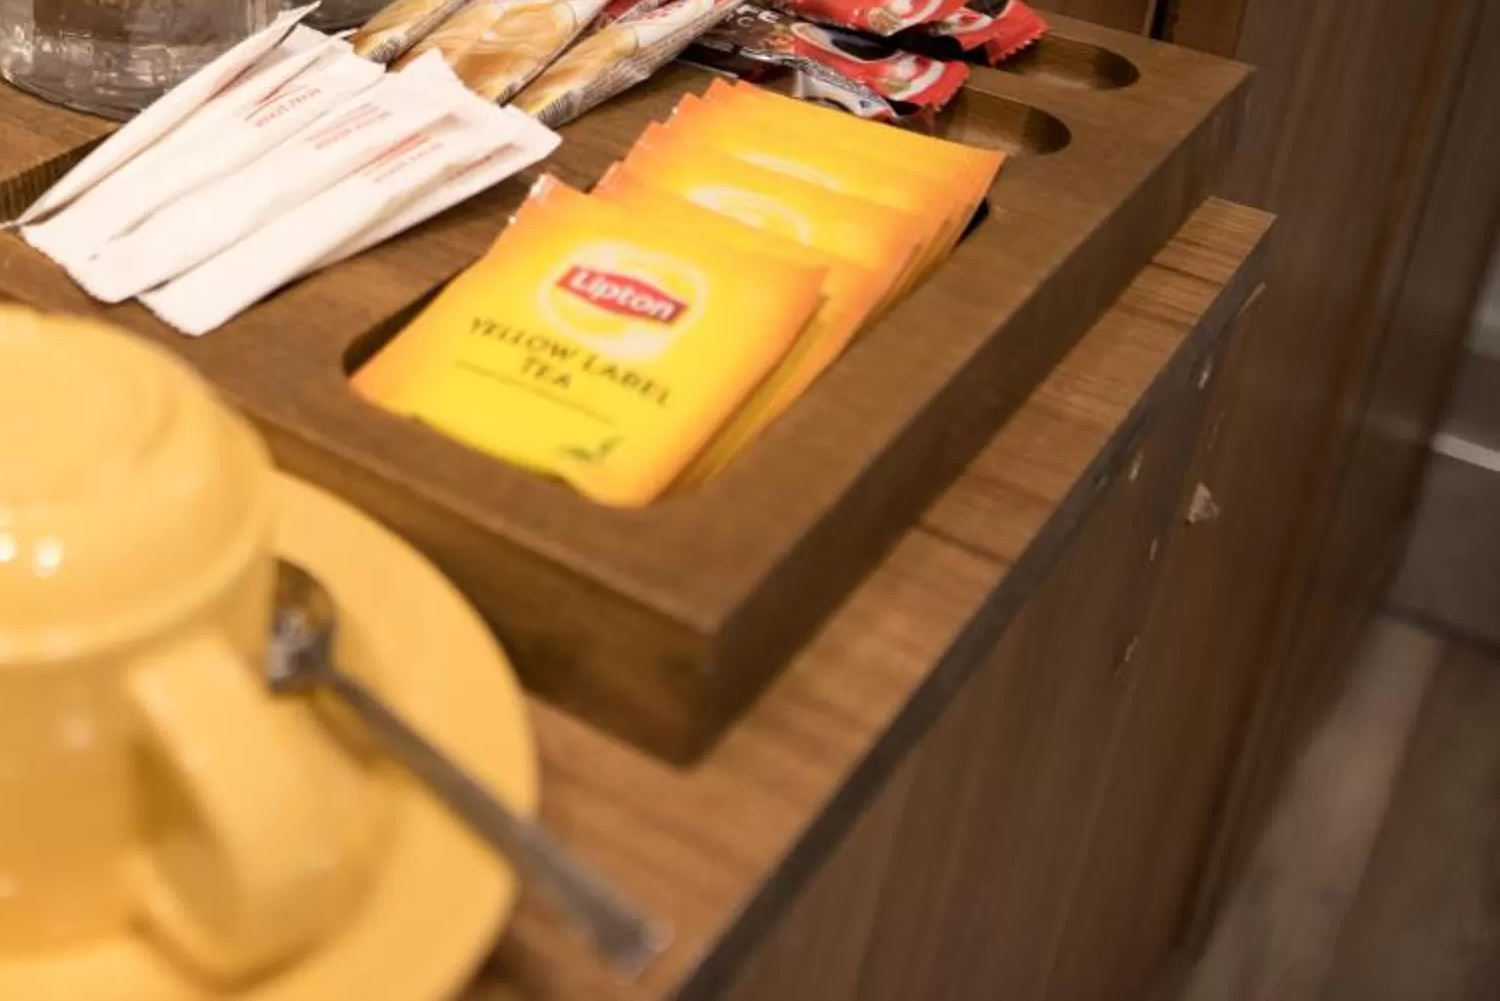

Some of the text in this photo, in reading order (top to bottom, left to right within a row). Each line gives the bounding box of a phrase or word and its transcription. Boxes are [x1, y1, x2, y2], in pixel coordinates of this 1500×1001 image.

[567, 269, 678, 321] Lipton
[468, 316, 672, 408] YELLOW LABEL
[520, 355, 572, 390] TEA
